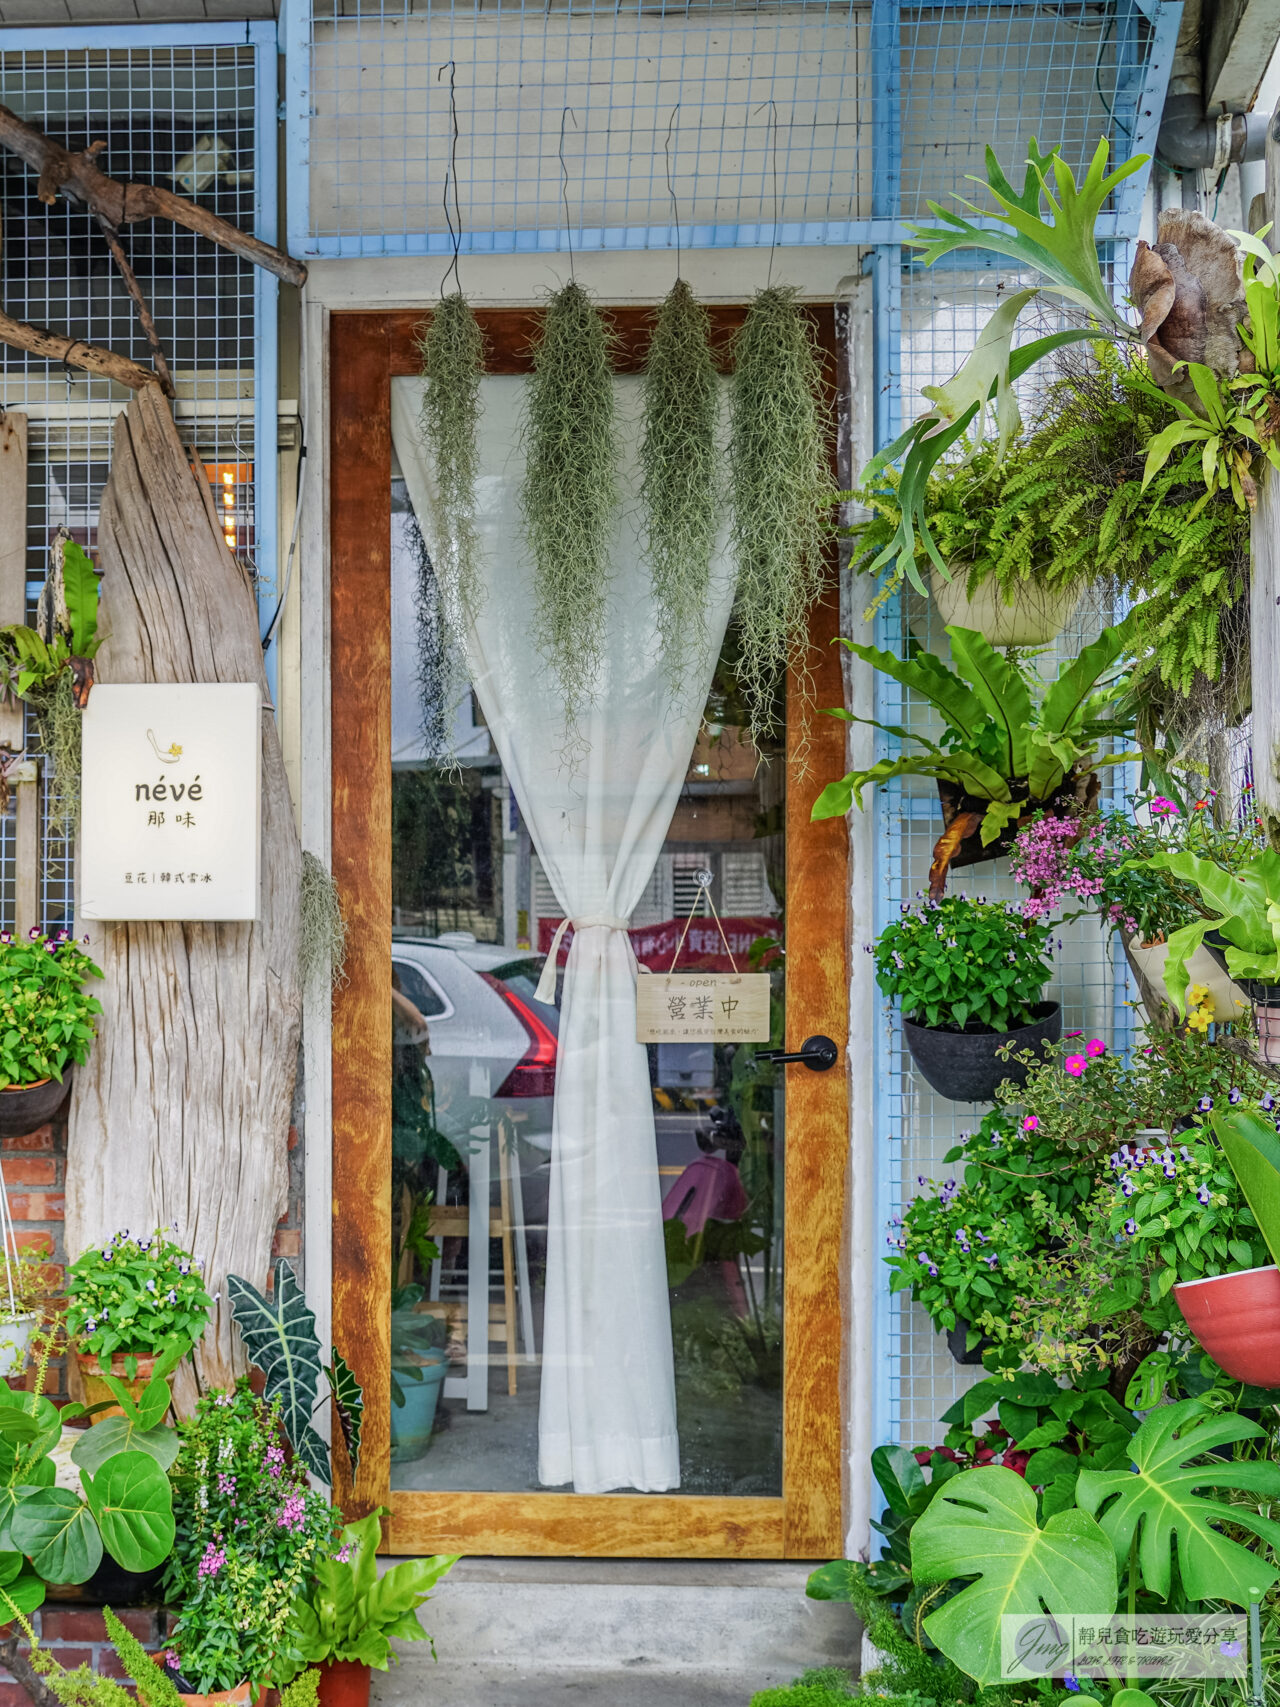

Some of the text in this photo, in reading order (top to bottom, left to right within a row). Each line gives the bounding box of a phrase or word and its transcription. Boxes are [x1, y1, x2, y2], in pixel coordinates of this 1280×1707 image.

[135, 774, 203, 802] névé
[147, 810, 196, 829] 那味
[689, 978, 717, 989] open
[667, 994, 740, 1020] 營業中
